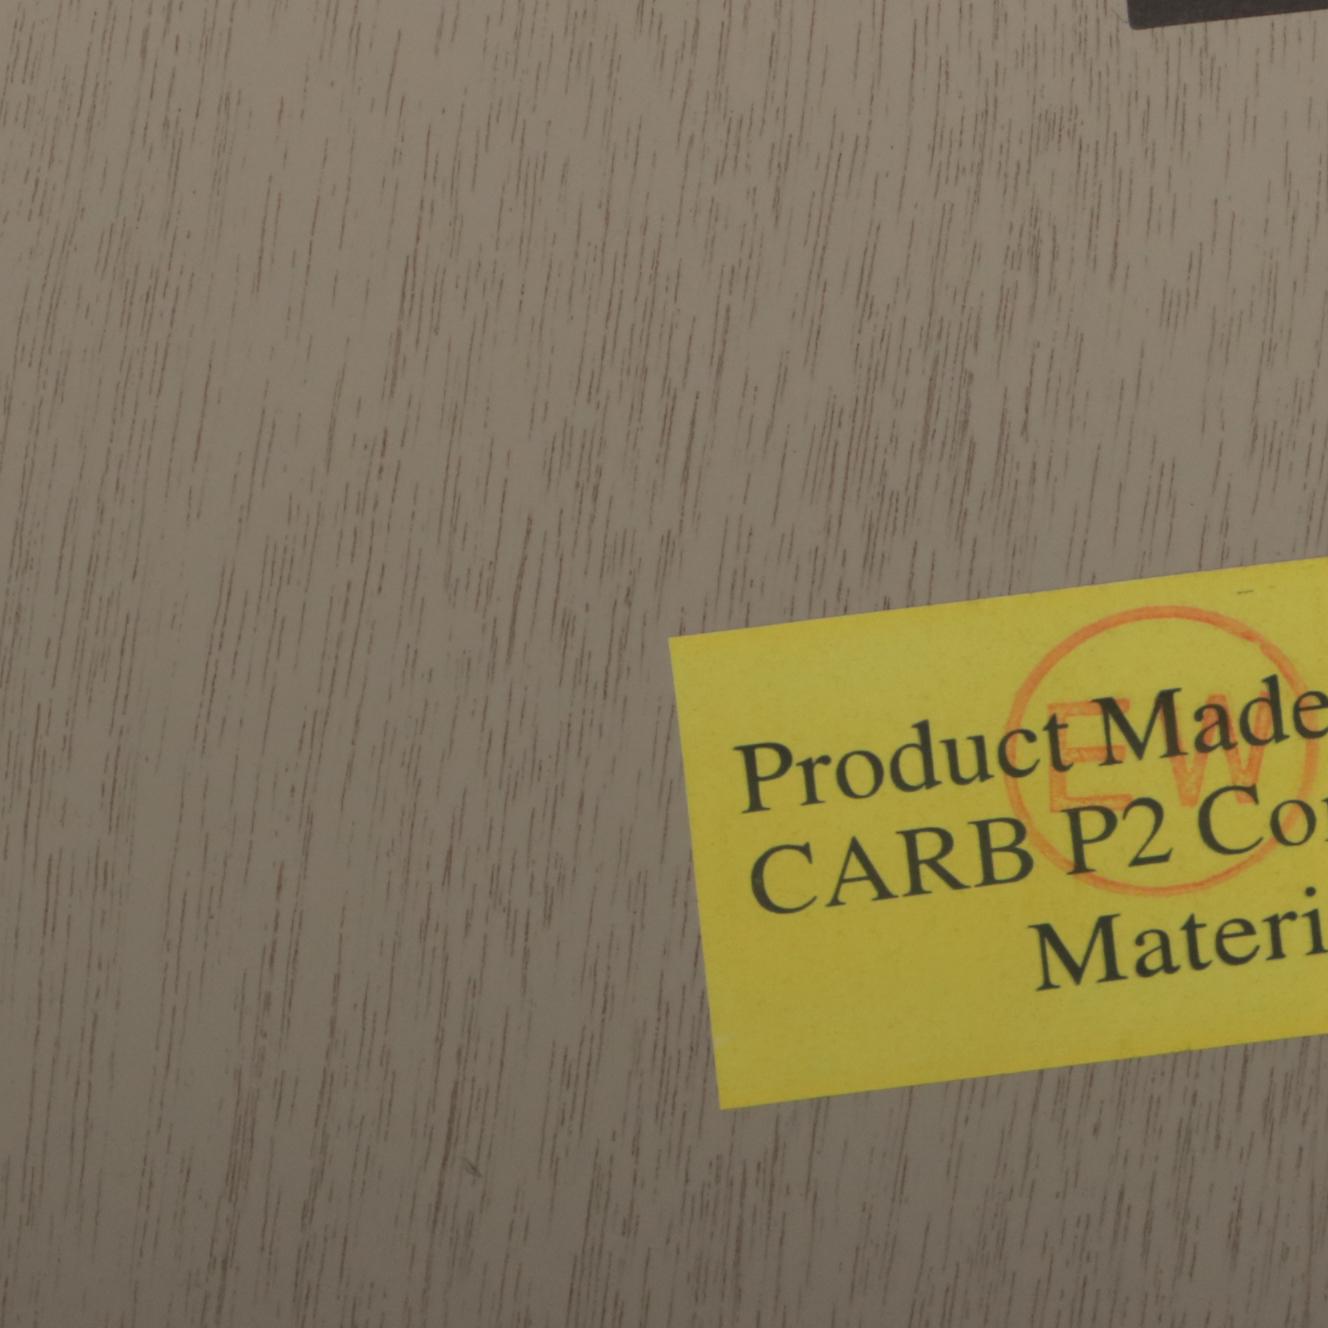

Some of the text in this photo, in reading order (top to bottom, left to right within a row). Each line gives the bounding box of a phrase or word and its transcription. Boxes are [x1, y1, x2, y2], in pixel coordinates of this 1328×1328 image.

[734, 714, 1072, 813] Product
[1043, 690, 1270, 815] EW
[751, 818, 1033, 914] CARB
[1062, 797, 1172, 874] P2
